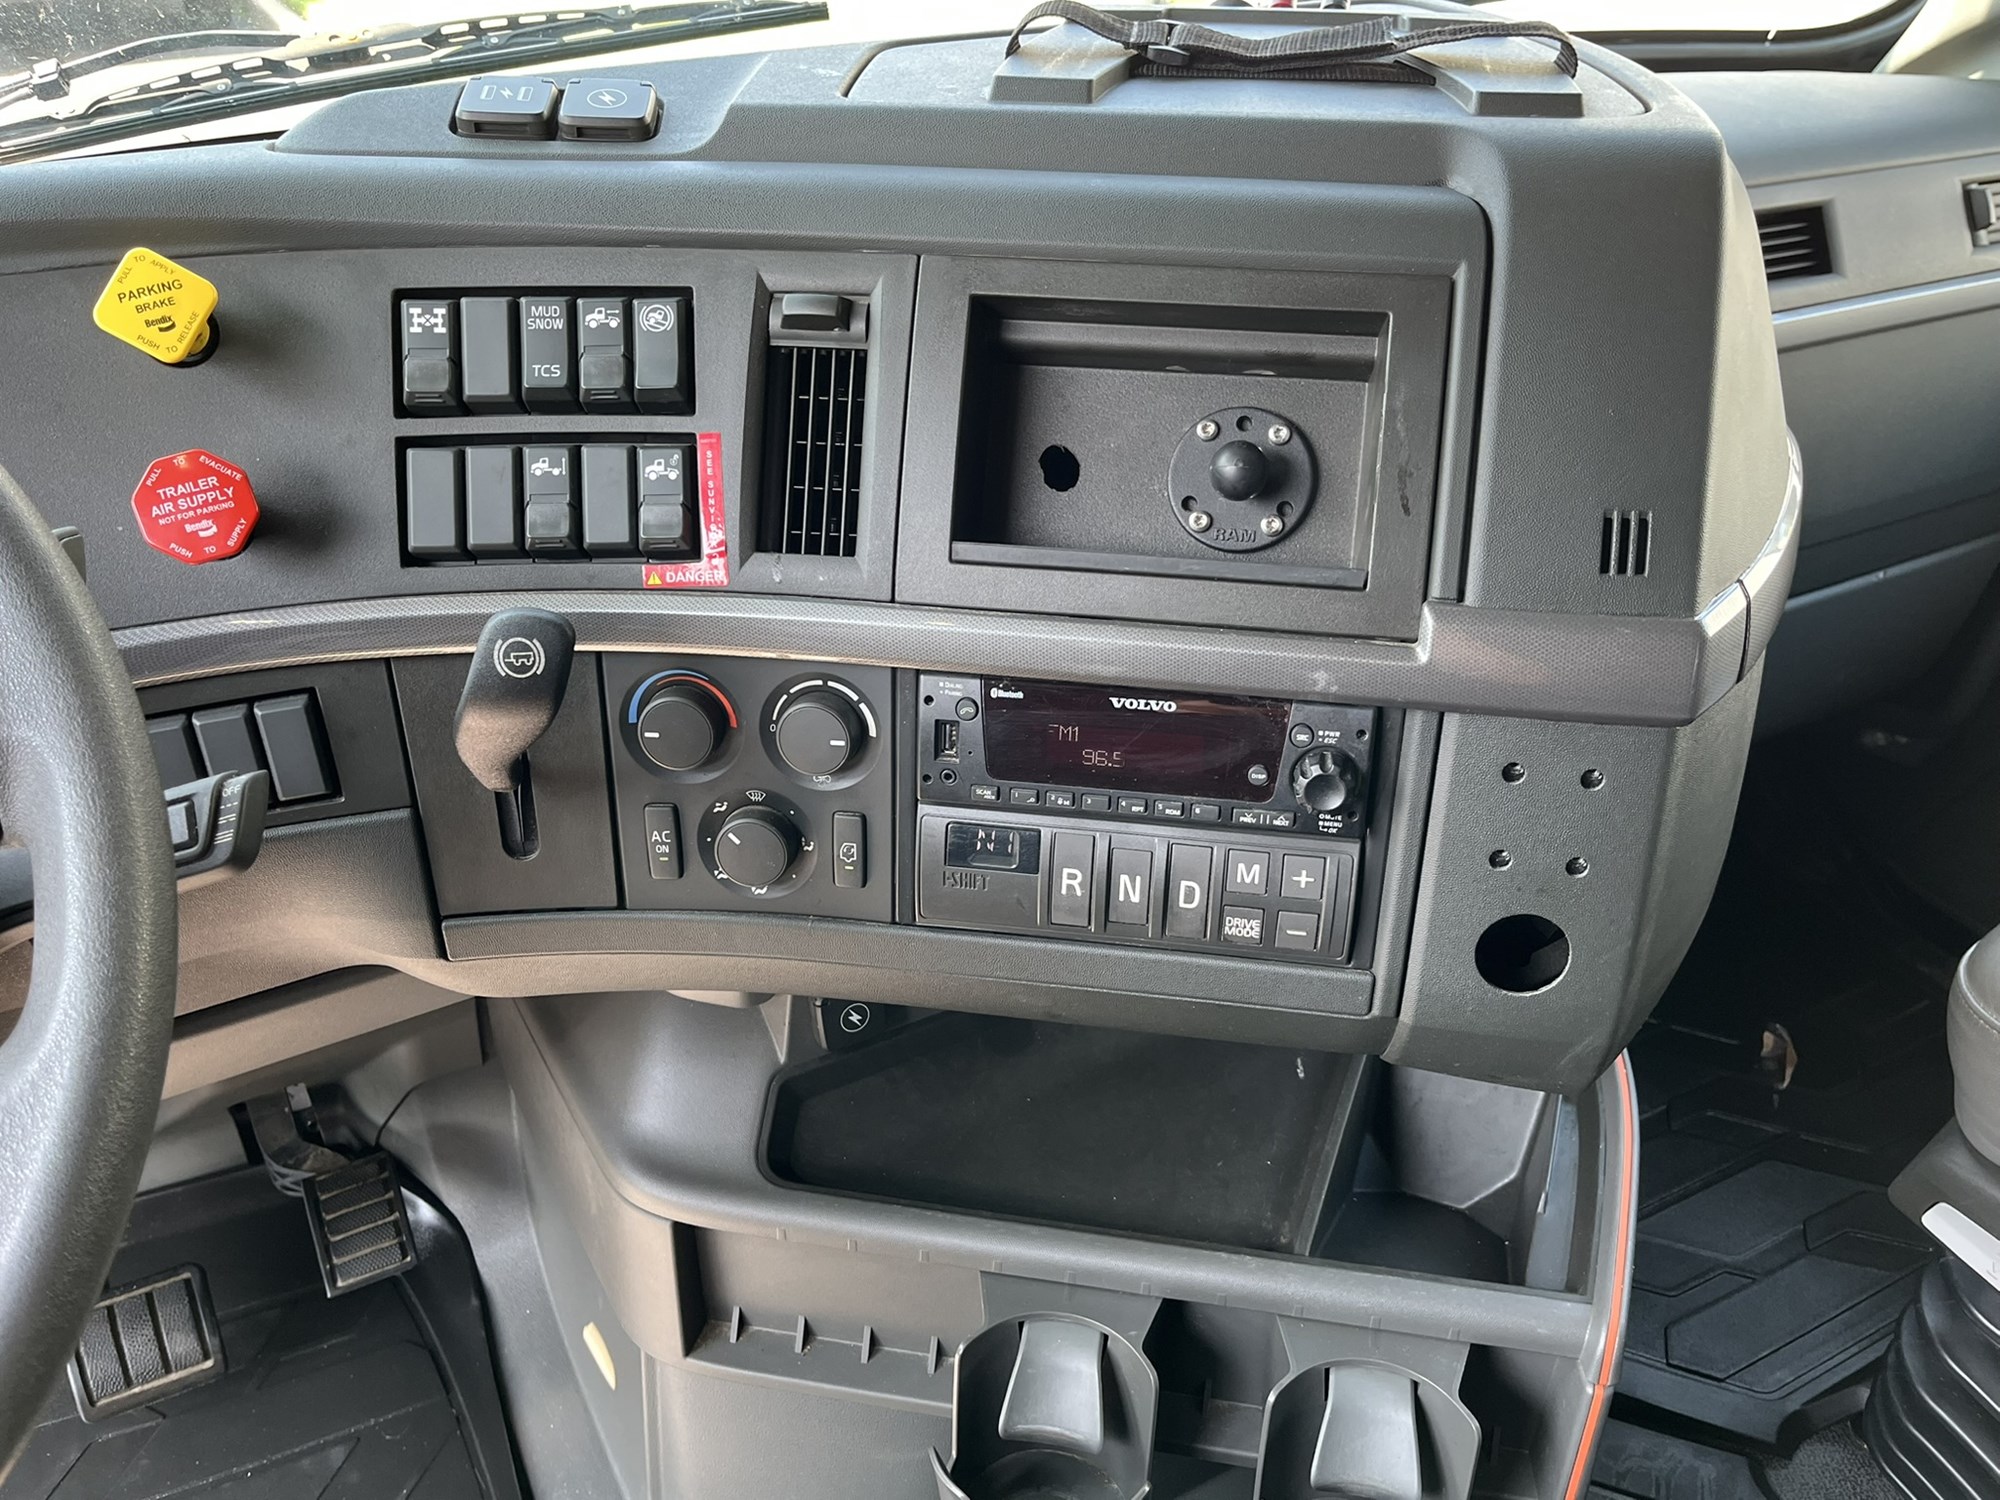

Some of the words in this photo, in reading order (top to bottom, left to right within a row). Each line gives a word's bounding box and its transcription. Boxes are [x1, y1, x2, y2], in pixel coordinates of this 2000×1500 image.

[118, 266, 132, 284] PULL
[134, 254, 146, 263] TO
[150, 259, 175, 275] APPLY
[117, 279, 183, 303] PARKING
[135, 296, 176, 314] BRAKE
[531, 305, 560, 317] MUD
[144, 314, 173, 328] Bendix
[527, 318, 563, 330] SNOW
[137, 334, 160, 350] PUSH
[166, 345, 178, 354] TO
[177, 311, 200, 344] RELEASE
[532, 364, 561, 377] TCS
[146, 467, 162, 487] PULL
[173, 456, 186, 466] TO
[199, 455, 243, 481] EVACUATE
[706, 450, 714, 476] SEE
[156, 476, 219, 500] TRAILER
[151, 500, 176, 518] AIR
[178, 486, 234, 510] SUPPLY
[158, 516, 176, 526] NOT
[178, 510, 196, 521] FOR
[197, 500, 235, 516] PARKING
[184, 518, 215, 533] Bendix
[1213, 528, 1257, 543] RAM
[169, 543, 193, 559] PUSH
[203, 545, 217, 555] TO
[227, 517, 247, 547] SUPPLY
[666, 570, 723, 583] DANGER
[1109, 697, 1177, 712] VOLVO
[1082, 749, 1125, 768] 96.5
[651, 830, 671, 843] AC
[655, 844, 669, 853] ON
[943, 871, 990, 892] I-SHIFT
[1061, 867, 1083, 897] R
[1236, 863, 1260, 885] M
[1118, 874, 1141, 903] N
[1178, 880, 1201, 909] D
[1224, 926, 1260, 939] MODE
[1225, 916, 1261, 932] DRIVE
